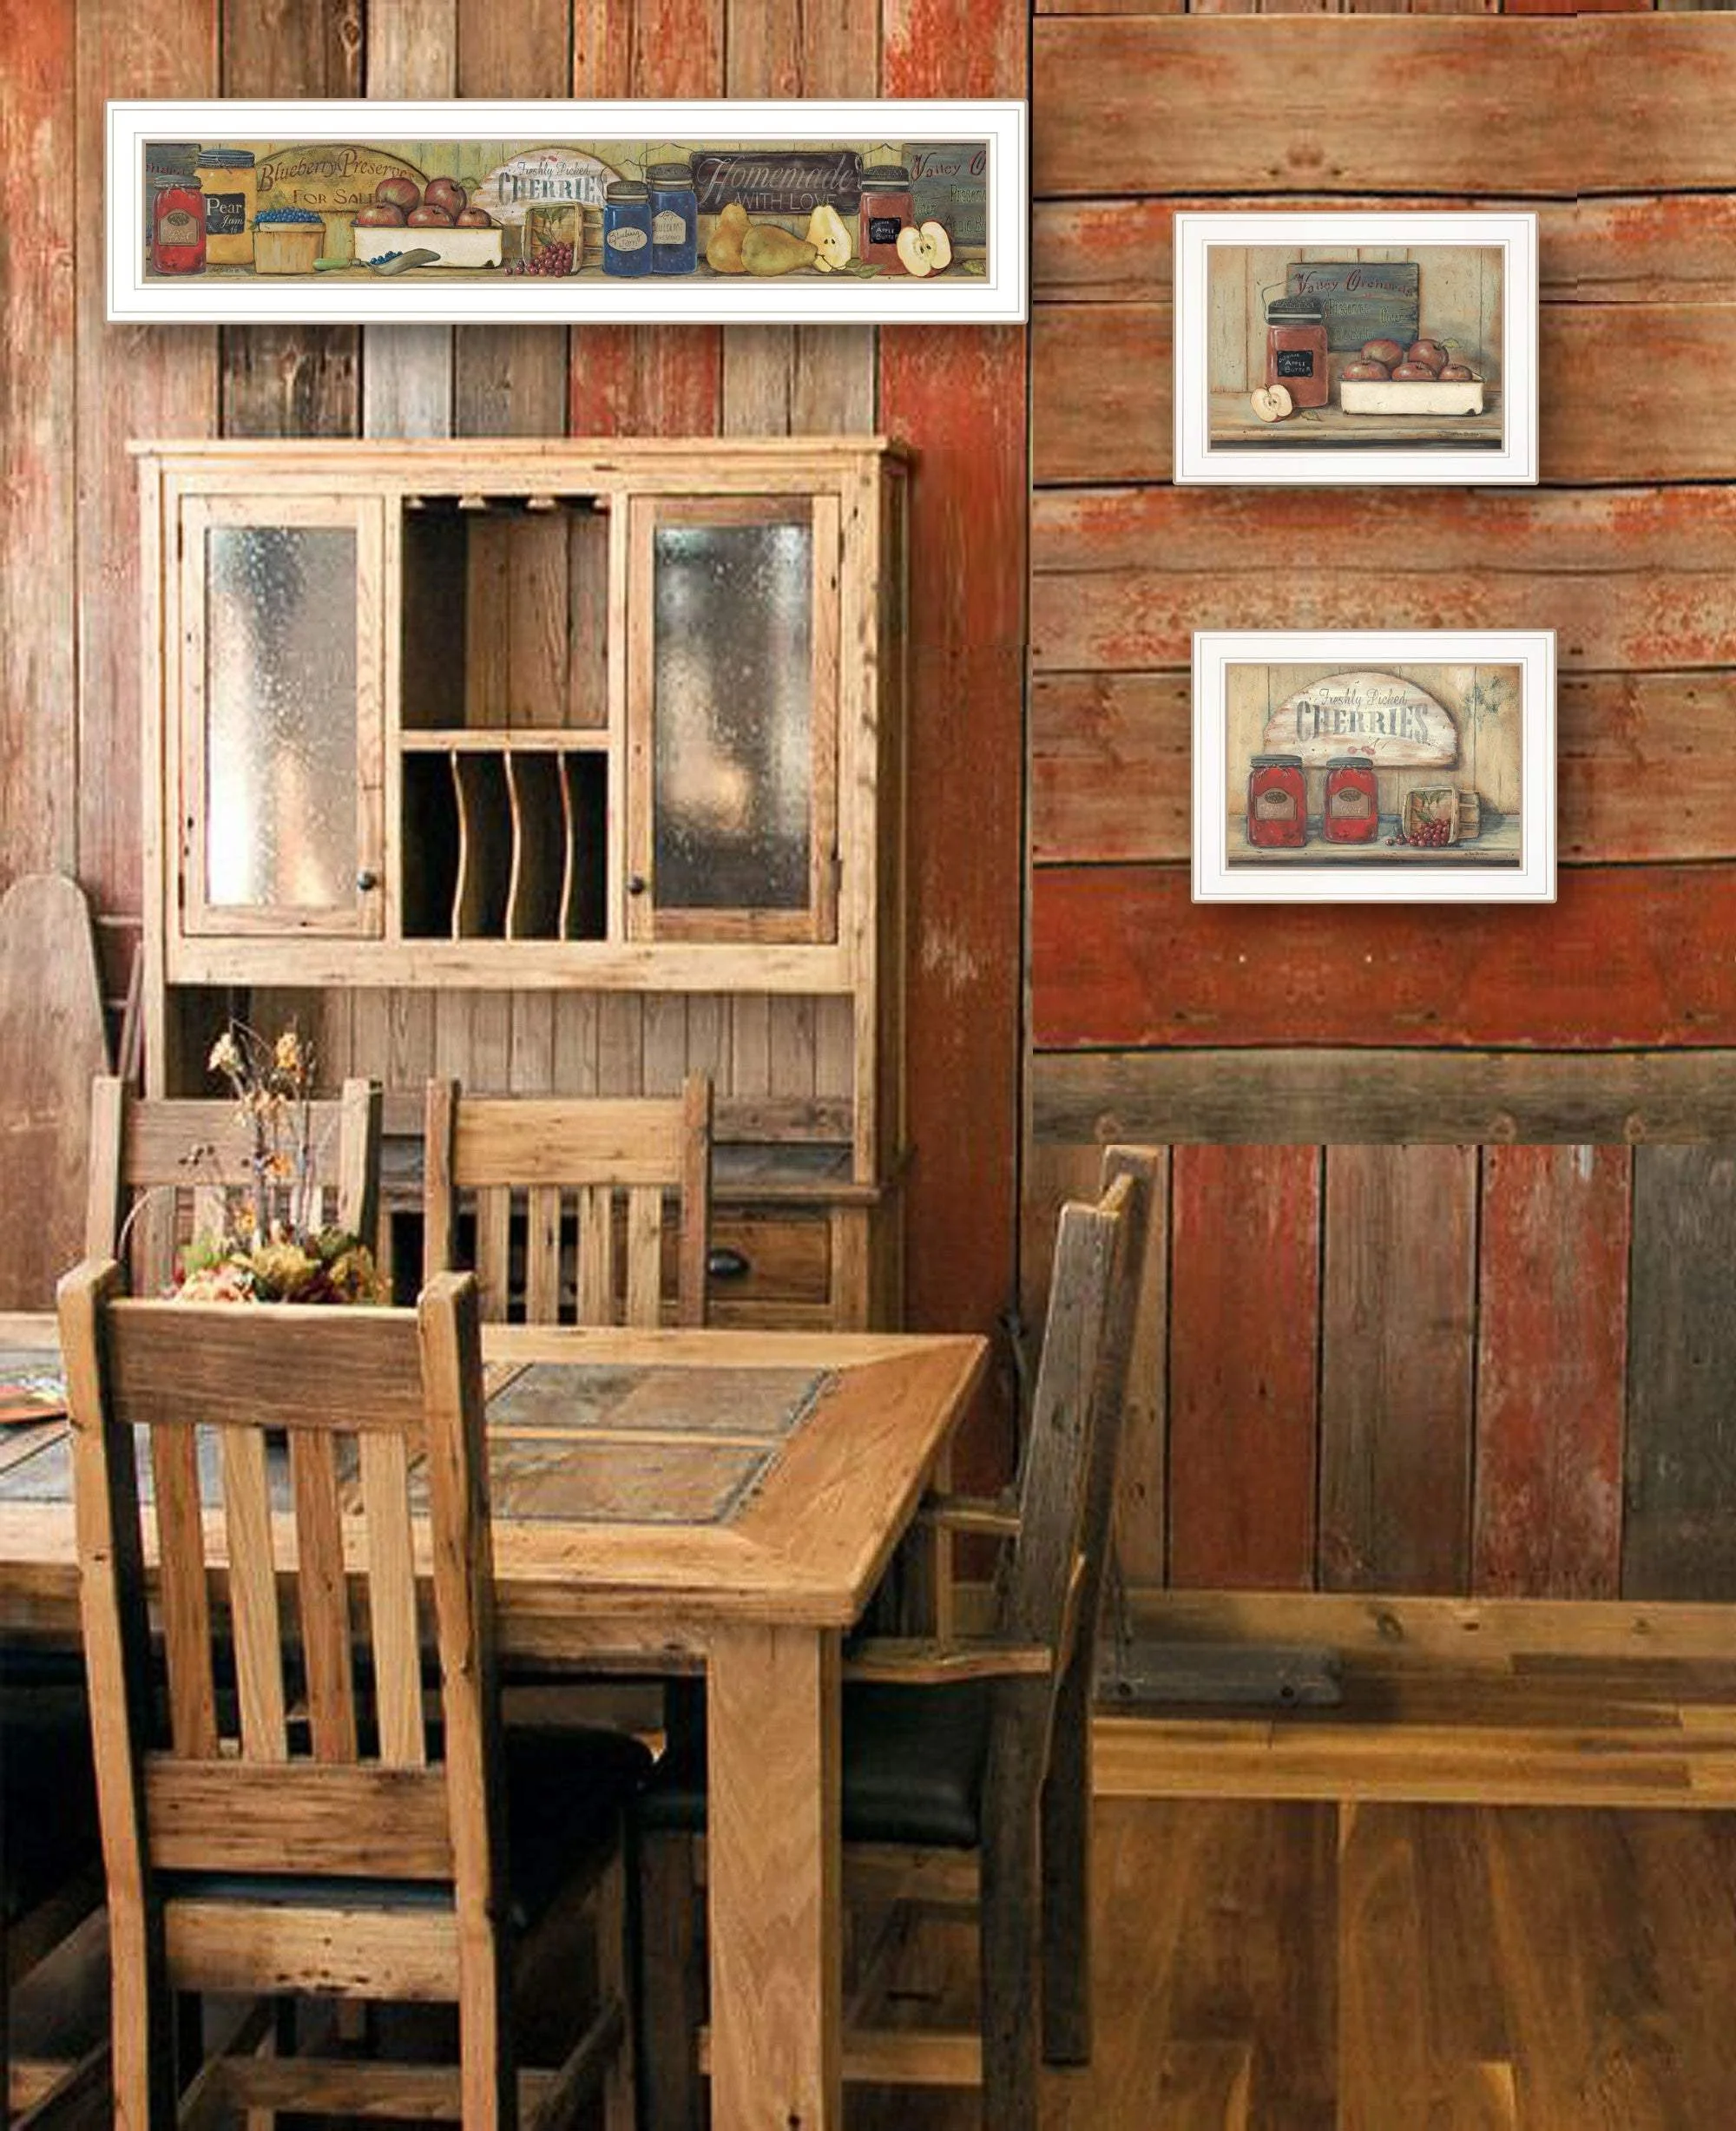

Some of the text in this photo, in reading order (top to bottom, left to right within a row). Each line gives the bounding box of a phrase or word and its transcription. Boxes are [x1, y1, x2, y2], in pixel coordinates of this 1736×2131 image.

[258, 158, 339, 192] Blueberry
[696, 153, 855, 207] Homemade
[911, 152, 961, 181] Valley
[206, 197, 242, 216] Pear
[734, 193, 783, 210] WITH
[1318, 687, 1407, 709] Freshly Picked
[1296, 700, 1429, 744] CHERRIES
